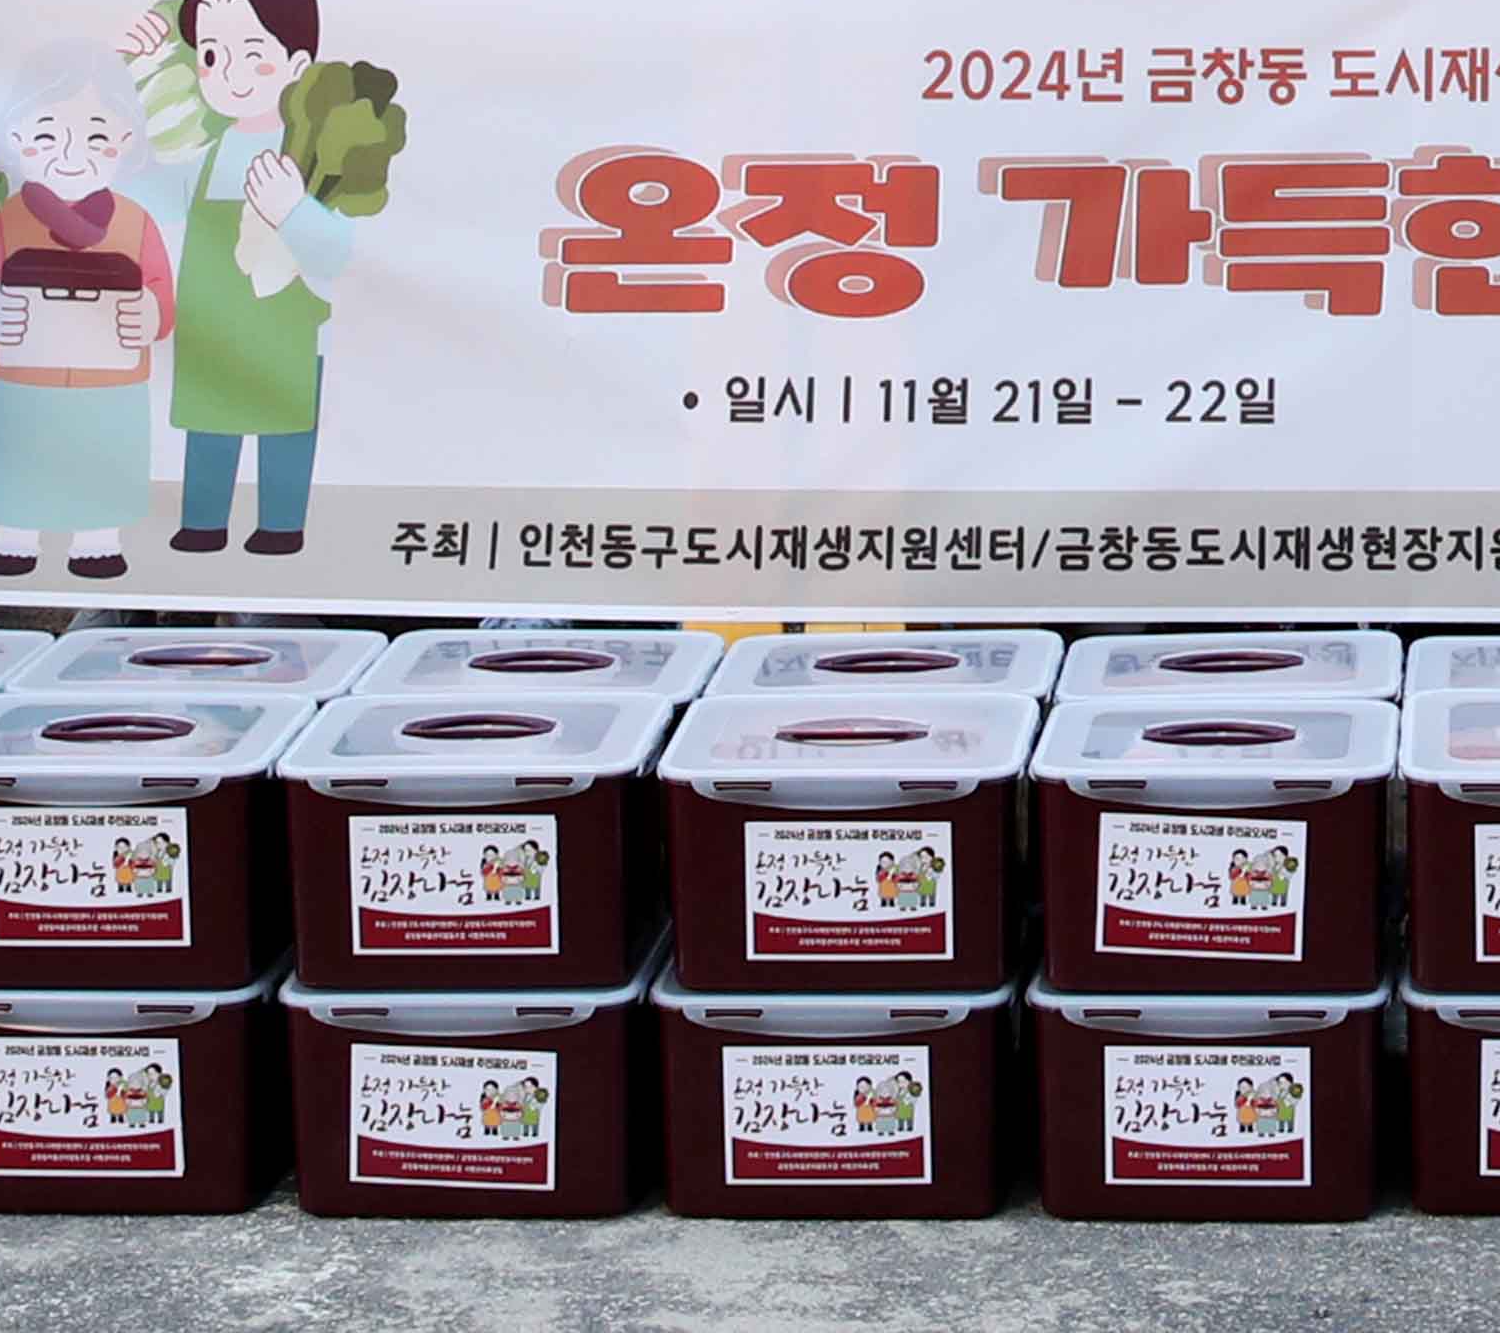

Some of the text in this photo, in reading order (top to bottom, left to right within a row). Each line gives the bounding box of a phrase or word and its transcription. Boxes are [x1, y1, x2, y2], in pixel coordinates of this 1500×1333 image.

[924, 48, 1124, 103] 2024년
[1150, 48, 1306, 106] 금창동
[545, 148, 941, 319] 온정
[726, 376, 814, 423] 일시
[880, 377, 968, 425] 11월
[993, 378, 1092, 425] 21일
[1166, 378, 1274, 424] 22일
[390, 521, 469, 567] 주최
[361, 869, 475, 908] 김장나눔
[755, 875, 870, 914] 김장나눔
[1107, 869, 1222, 908] 김장나눔
[360, 1100, 473, 1139] 김장나눔
[734, 1100, 848, 1139] 김장나눔
[1115, 1100, 1229, 1138] 김장나눔
